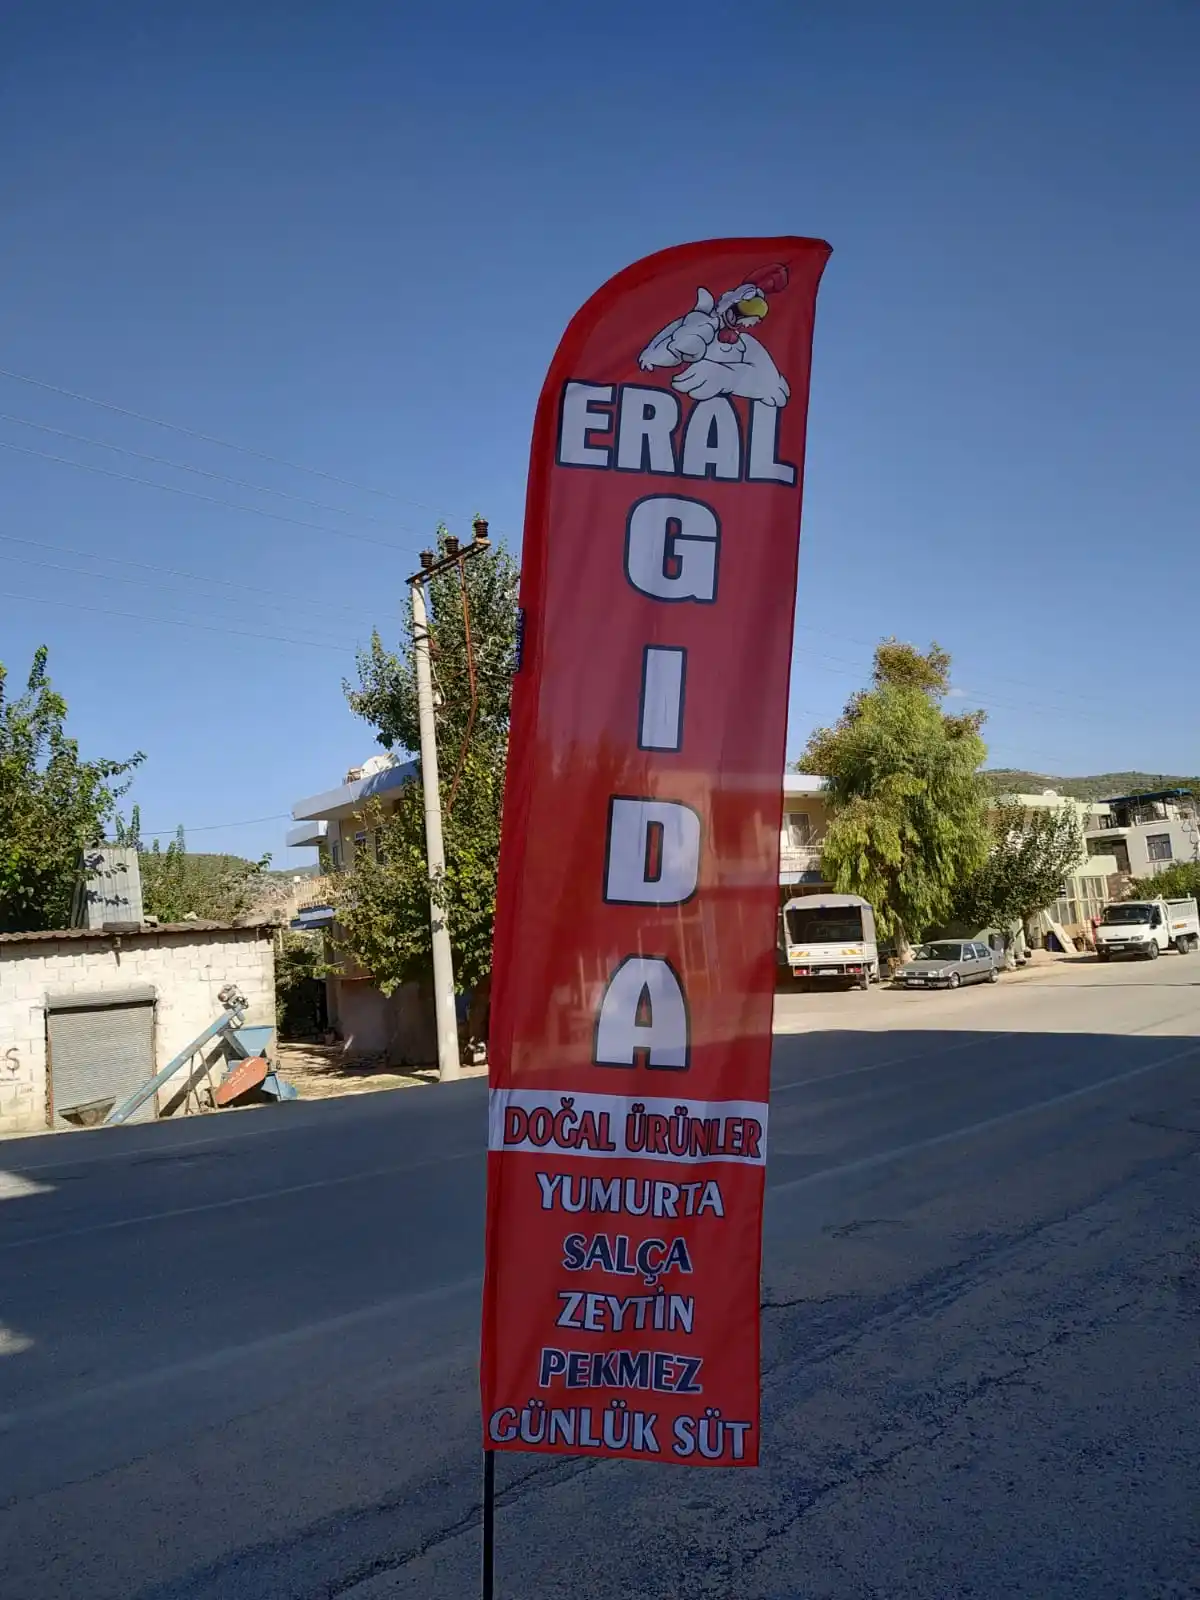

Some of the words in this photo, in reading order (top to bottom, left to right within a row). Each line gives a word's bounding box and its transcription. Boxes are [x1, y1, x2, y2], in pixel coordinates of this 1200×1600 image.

[555, 378, 797, 487] ERAL
[592, 493, 722, 1070] GIDA
[503, 1097, 616, 1151] DOĞAL
[624, 1103, 763, 1159] ÜRÜNLER
[535, 1171, 725, 1218] YUMURTA
[562, 1233, 693, 1285] SALÇA
[555, 1284, 694, 1334] ZEYTİN
[538, 1347, 704, 1395] PEKMEZ
[488, 1397, 660, 1454] GÜNLÜK
[671, 1407, 753, 1460] SÜT
